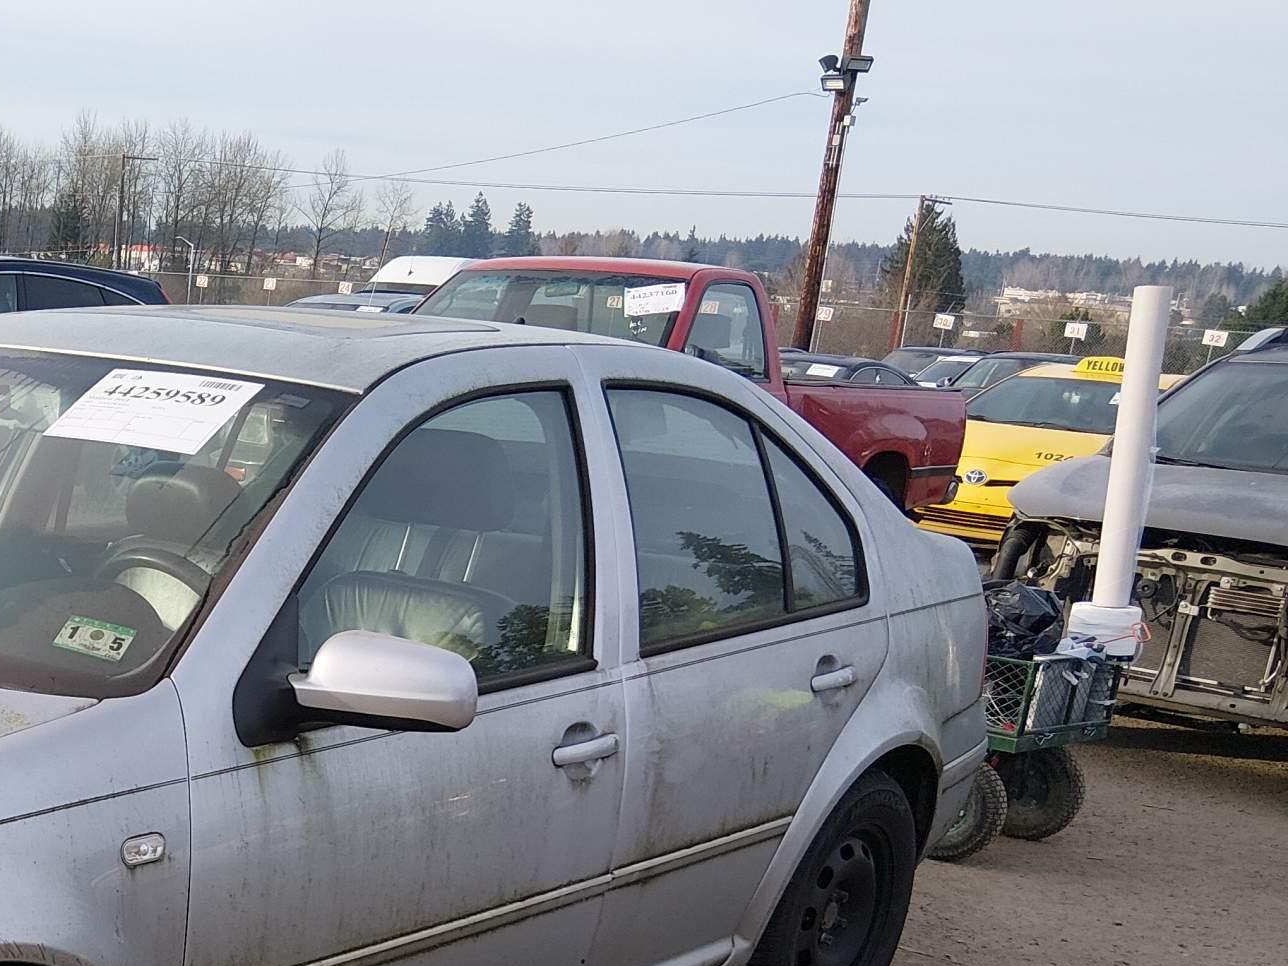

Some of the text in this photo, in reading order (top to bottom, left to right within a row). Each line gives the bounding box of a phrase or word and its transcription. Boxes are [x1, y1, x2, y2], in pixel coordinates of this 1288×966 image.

[1208, 334, 1222, 344] 32
[104, 384, 227, 407] 44259589
[67, 625, 81, 640] 1
[109, 636, 126, 652] 5
